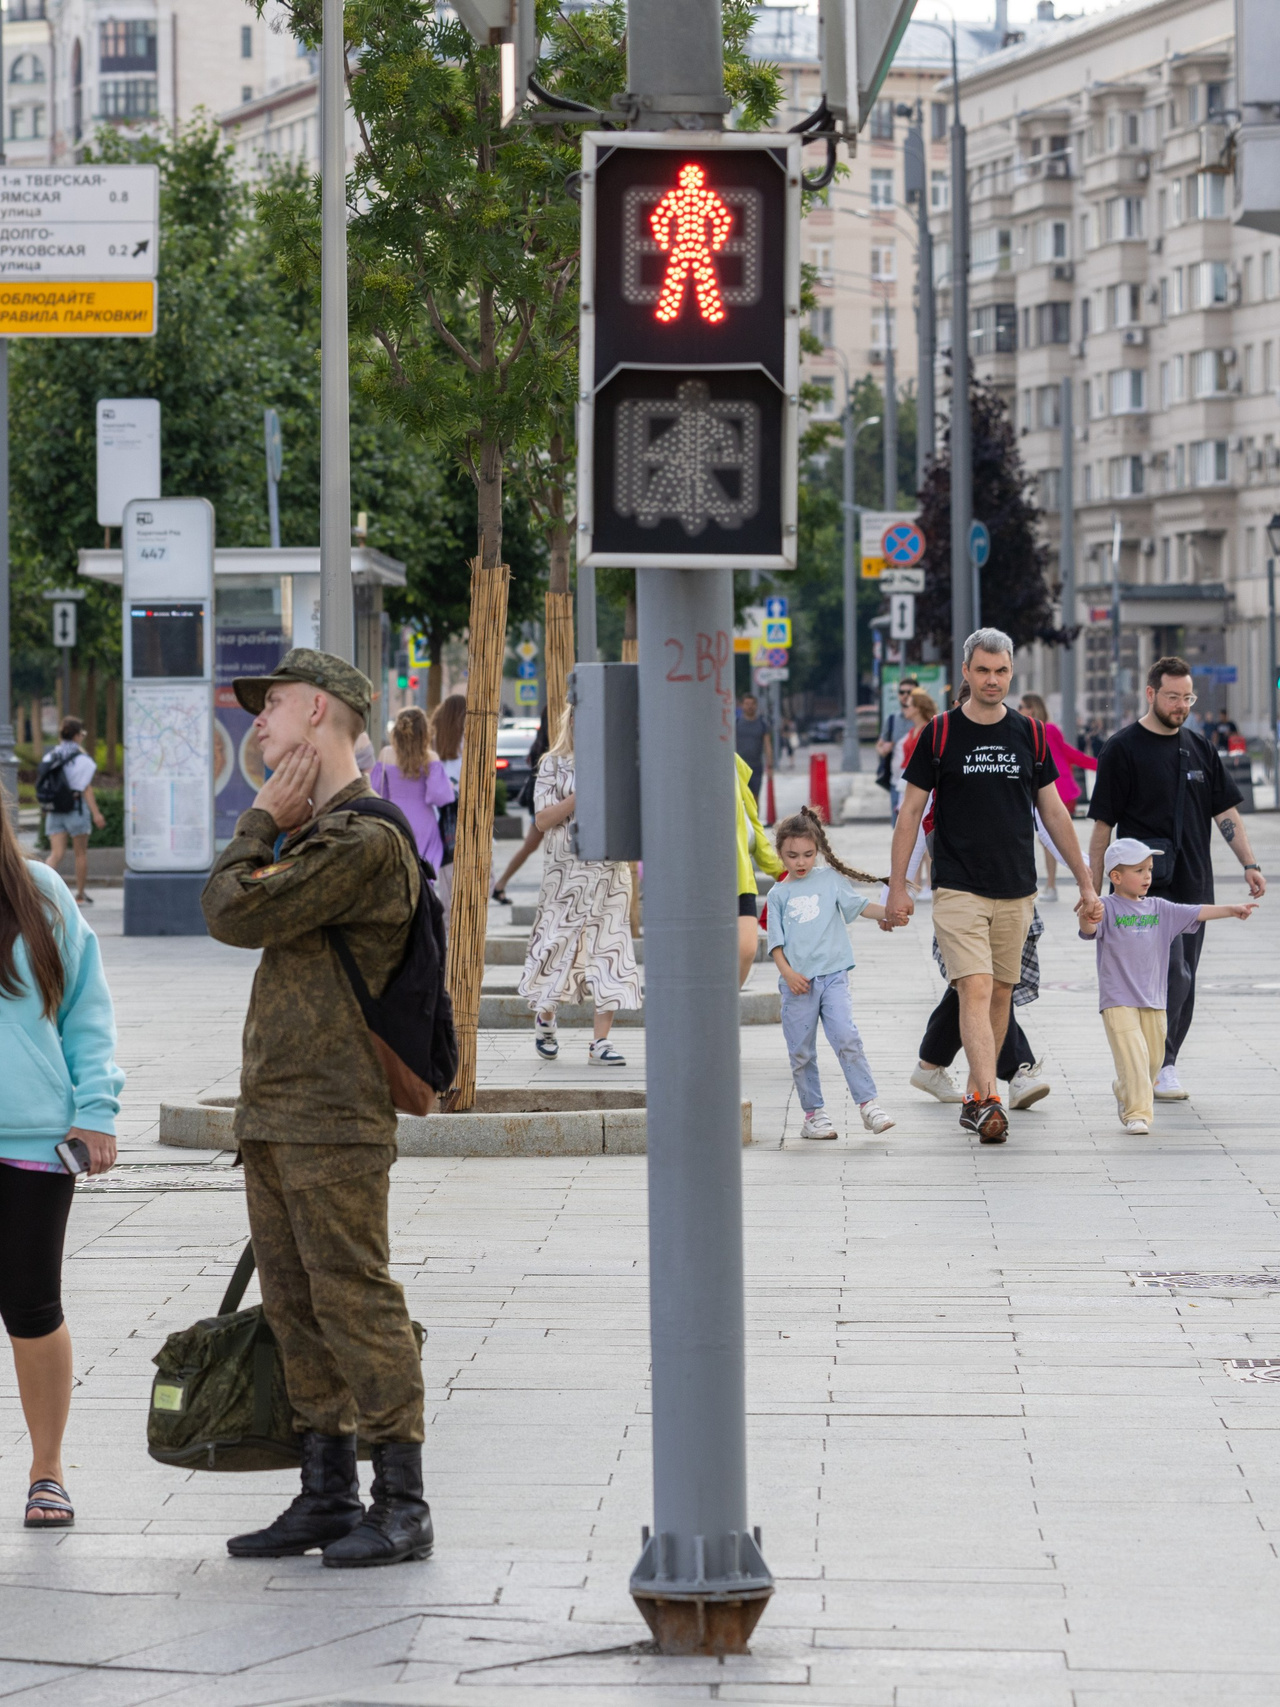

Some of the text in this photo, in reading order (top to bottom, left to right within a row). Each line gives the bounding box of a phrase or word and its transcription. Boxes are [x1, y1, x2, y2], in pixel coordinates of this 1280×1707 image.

[1, 174, 107, 186] 1-я ТВЕРСКАЯ-
[0, 191, 61, 203] ЯМСКАЯ
[109, 191, 129, 203] 0.8
[0, 207, 42, 220] улица
[0, 228, 54, 241] ДОЛГО-
[0, 245, 86, 257] РУКОВСКАЯ
[108, 245, 129, 257] 0.2
[0, 260, 41, 273] улица
[63, 310, 148, 322] ПАРКОВКИ!
[141, 548, 166, 560] 447
[965, 754, 972, 763] У
[975, 753, 995, 763] НАС
[963, 764, 1021, 774] ПОЛУЧИТСЯ!
